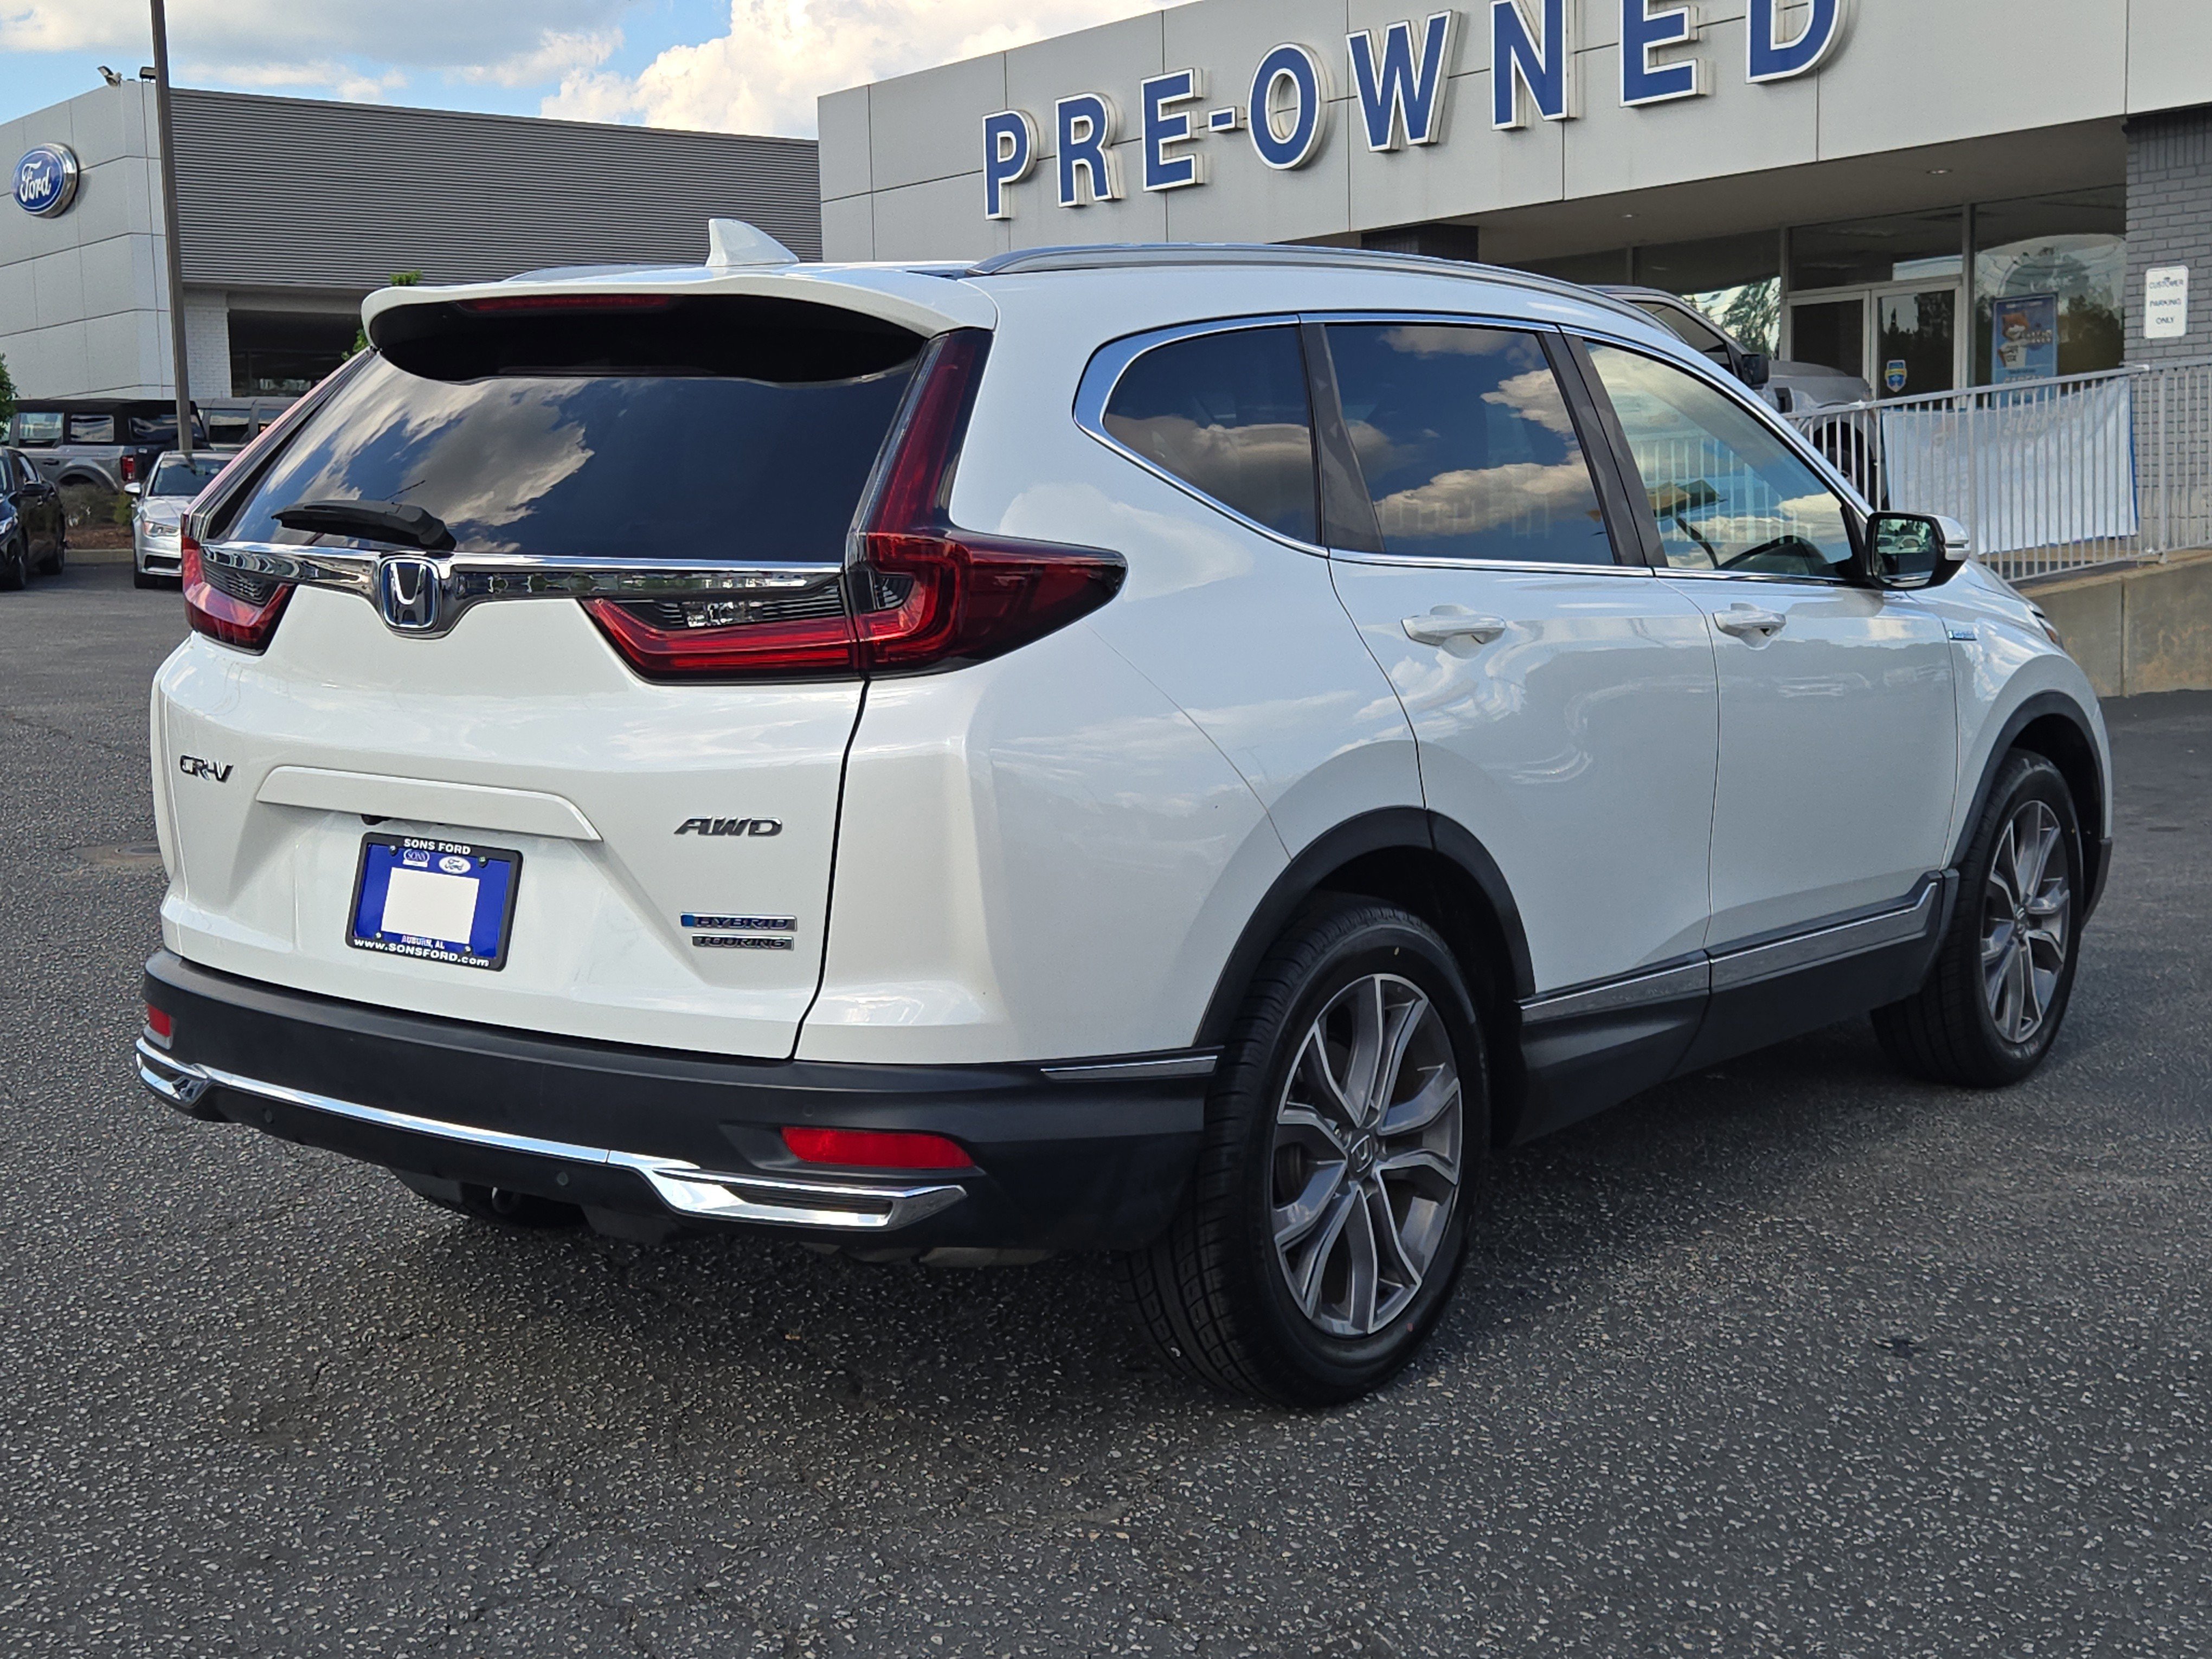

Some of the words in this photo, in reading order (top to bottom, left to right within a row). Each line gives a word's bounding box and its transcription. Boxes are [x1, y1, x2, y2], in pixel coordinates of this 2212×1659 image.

[982, 0, 1844, 220] PRE-OWNED
[20, 160, 52, 202] Ford
[2149, 279, 2184, 289] CUSTOMER
[2149, 298, 2182, 307] PARKING
[179, 753, 234, 783] CR-V
[673, 815, 783, 837] AWD
[403, 838, 435, 850] SONS
[438, 844, 471, 855] FORD
[696, 917, 788, 929] HYBRID
[434, 940, 446, 950] AL
[697, 937, 787, 949] TOURING
[353, 938, 490, 967] www.SONSFORD.com
